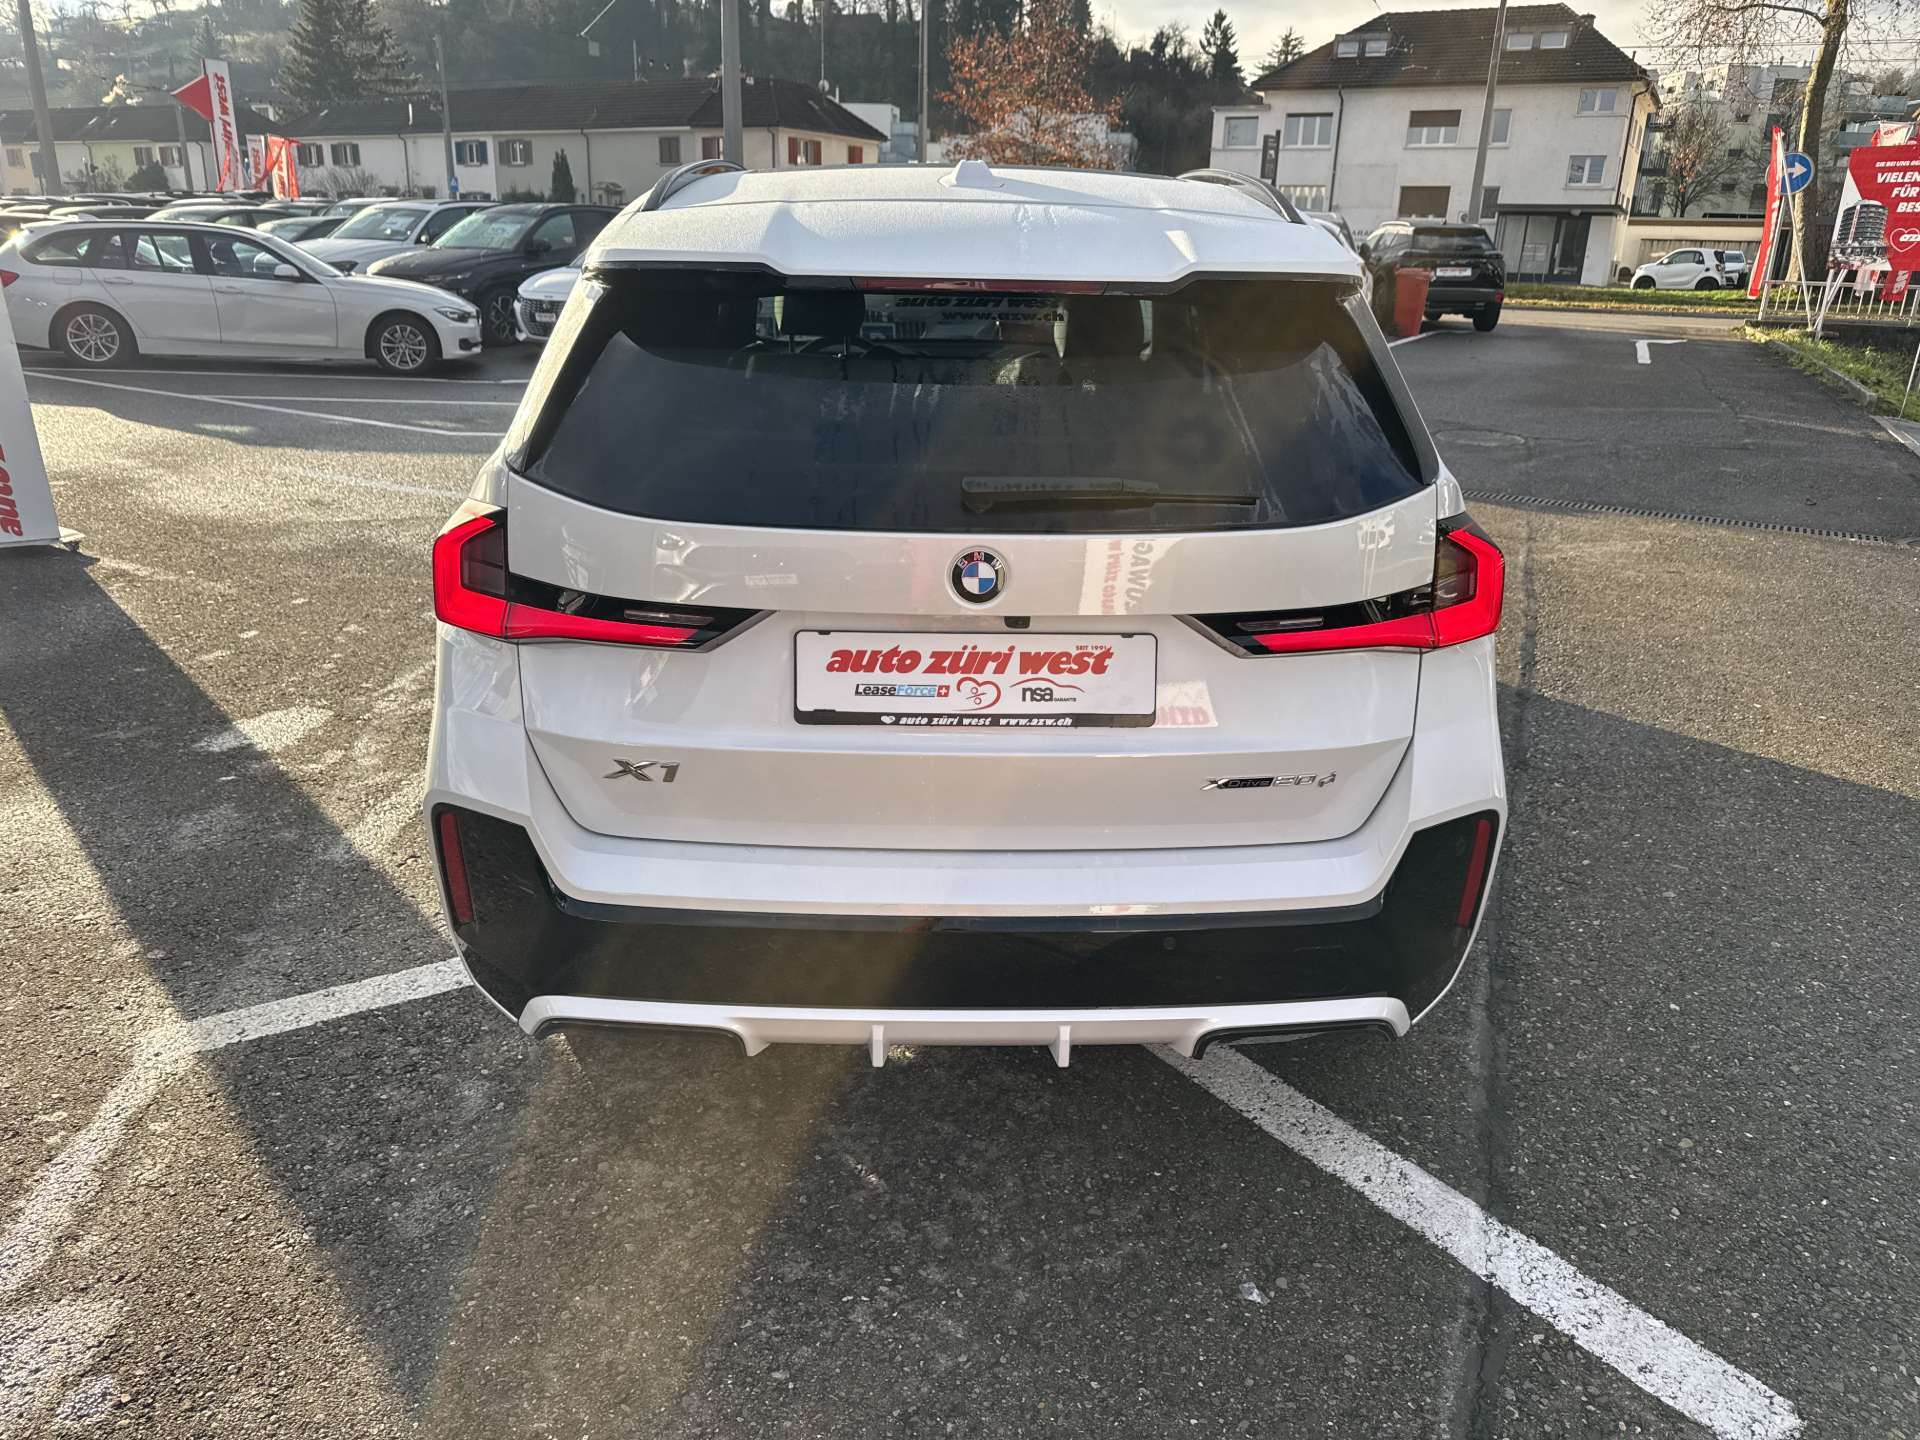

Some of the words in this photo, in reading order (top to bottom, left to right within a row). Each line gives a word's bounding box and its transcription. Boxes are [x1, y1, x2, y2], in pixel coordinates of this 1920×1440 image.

[214, 72, 230, 116] west
[1891, 184, 1919, 198] FÜR
[956, 550, 1003, 571] BMW
[826, 645, 922, 674] auto
[922, 645, 1016, 675] züri
[1019, 647, 1114, 675] west
[855, 684, 936, 697] LeaseForce
[1022, 687, 1053, 702] nsa
[899, 716, 928, 725] auto
[931, 716, 957, 725] züri
[962, 717, 991, 726] west
[999, 717, 1073, 726] www.azw.ch
[603, 759, 680, 782] X1
